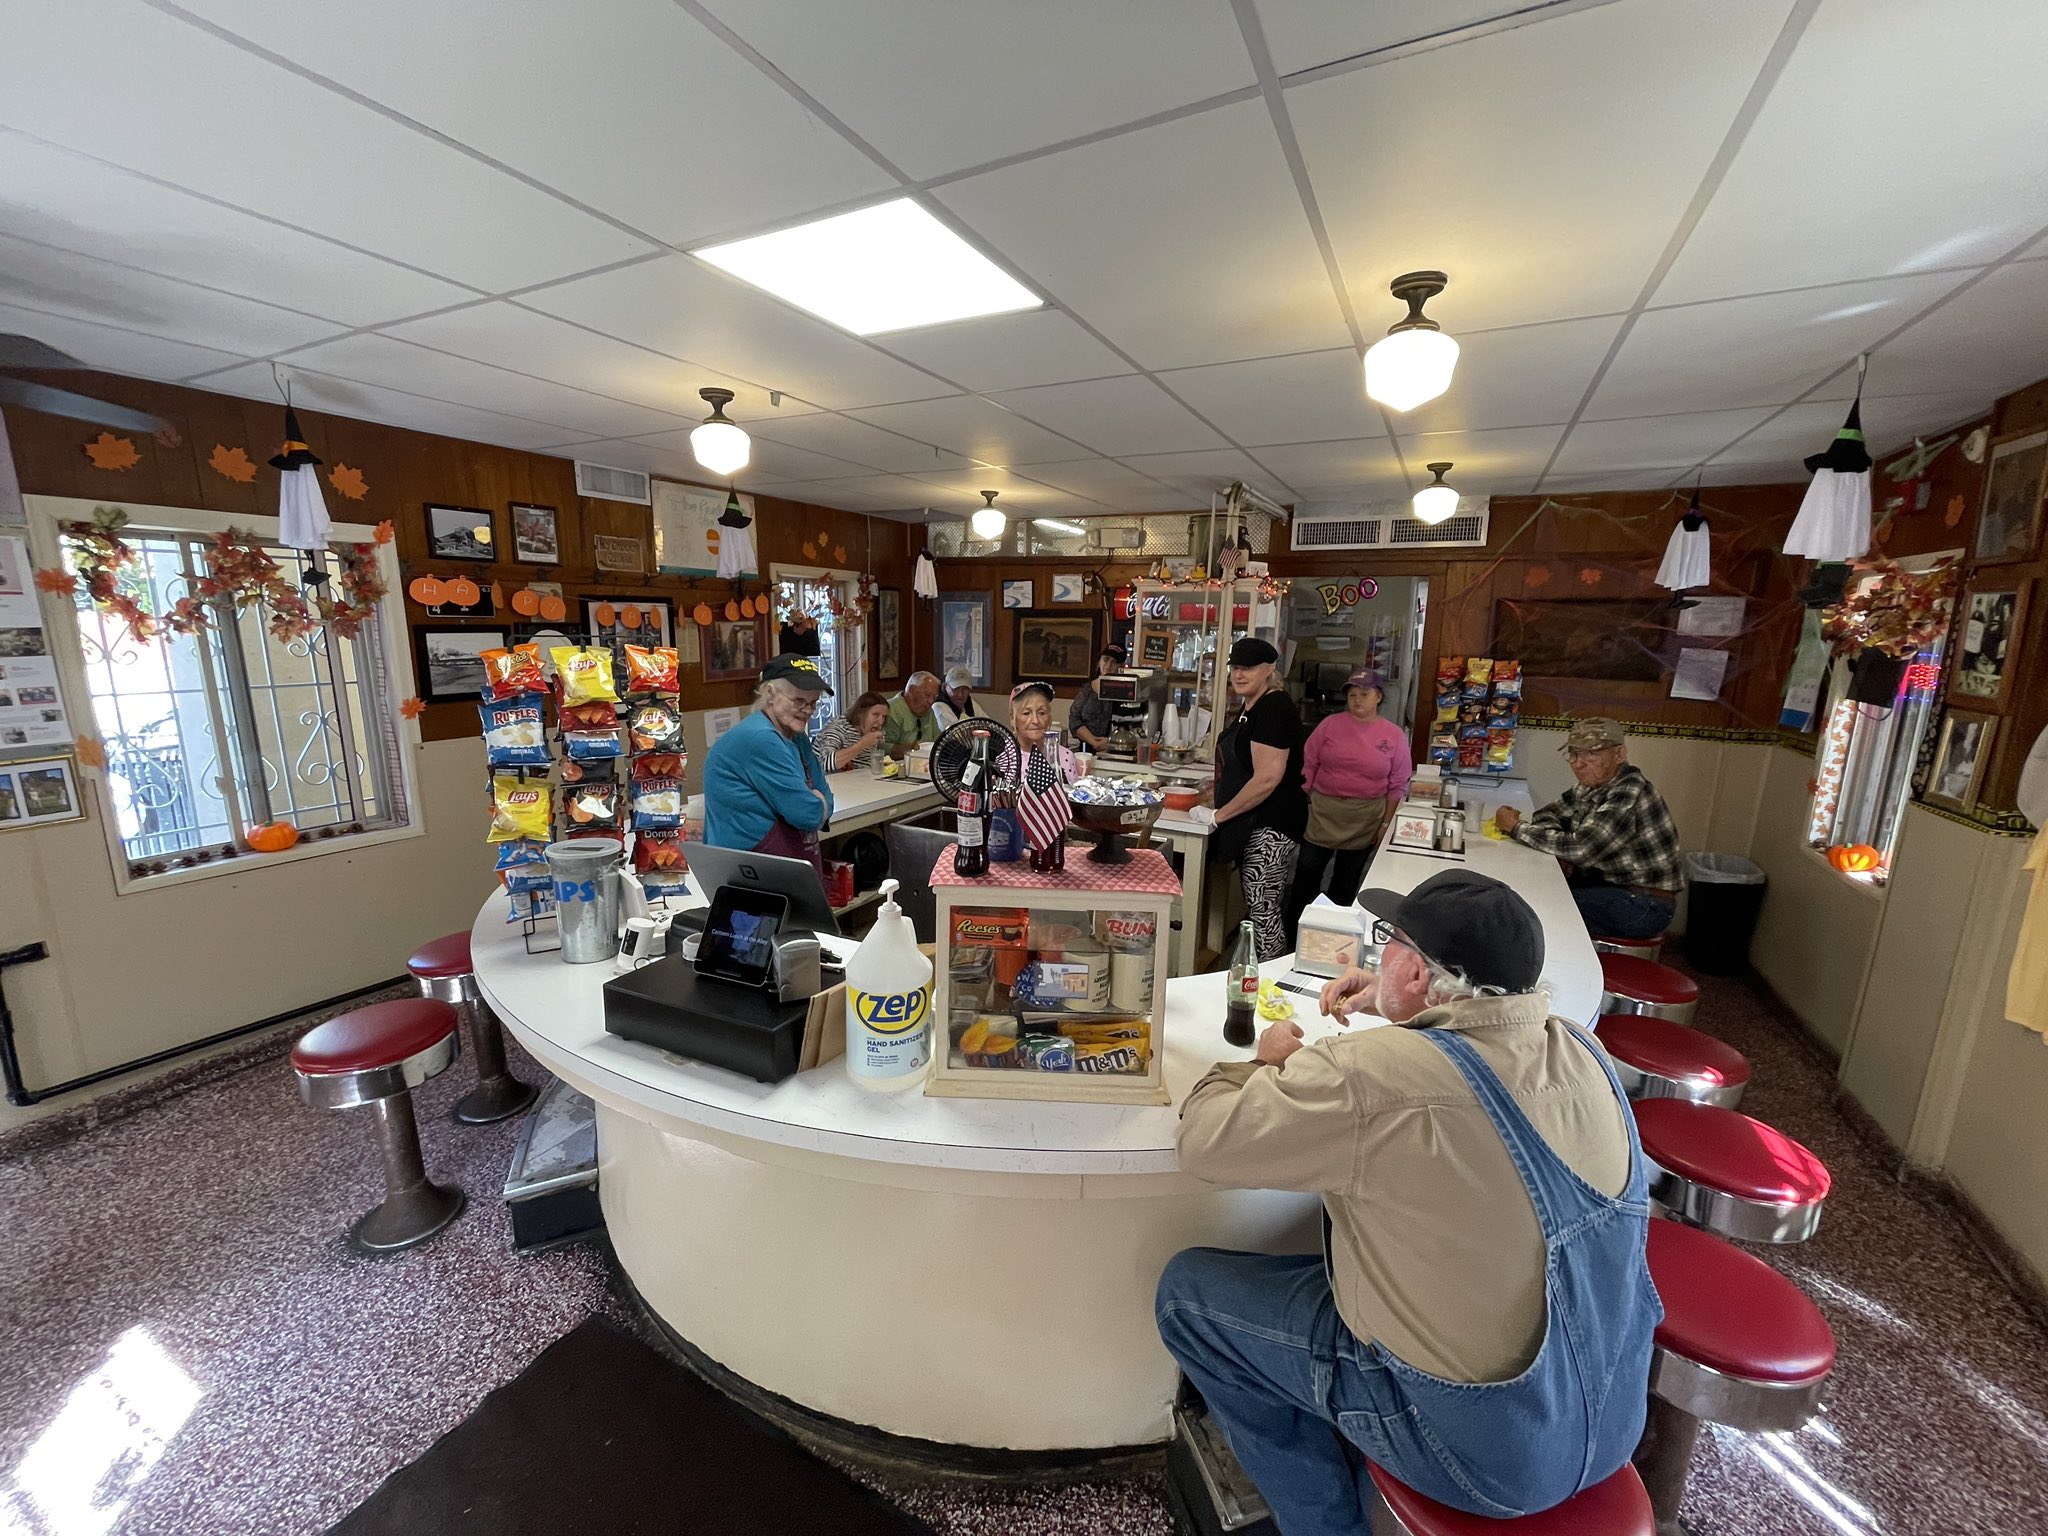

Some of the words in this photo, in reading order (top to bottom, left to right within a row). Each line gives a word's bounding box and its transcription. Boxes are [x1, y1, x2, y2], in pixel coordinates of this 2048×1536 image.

[1317, 578, 1378, 616] BOO
[509, 791, 539, 804] Lay's
[644, 830, 679, 839] Doritos
[956, 919, 1001, 934] Reese's
[1106, 919, 1154, 937] BUN
[866, 990, 921, 1023] Zep
[867, 1040, 888, 1048] HAND
[889, 1032, 923, 1047] SANITIZER
[867, 1046, 881, 1054] GEL
